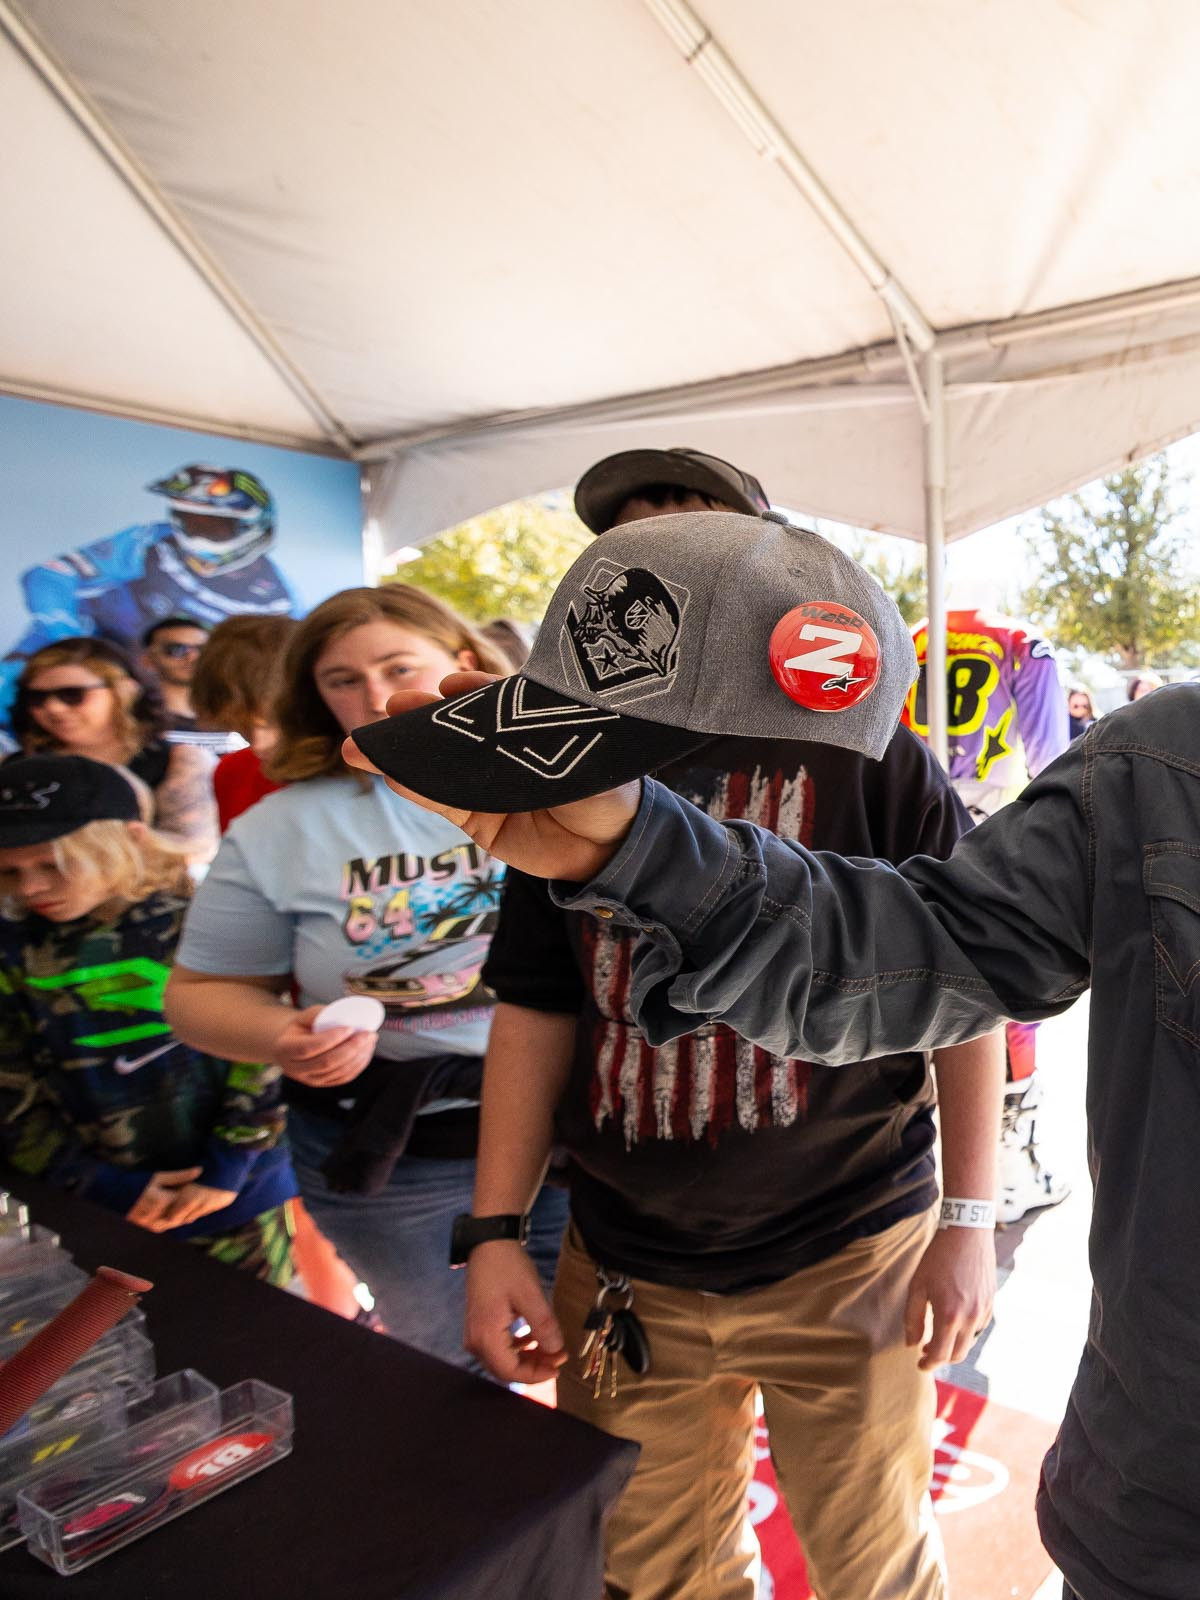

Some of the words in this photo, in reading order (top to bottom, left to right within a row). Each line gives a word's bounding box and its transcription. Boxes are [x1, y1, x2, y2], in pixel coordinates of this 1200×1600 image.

[801, 606, 865, 628] Webb
[341, 843, 481, 899] MUST
[342, 888, 415, 946] 64
